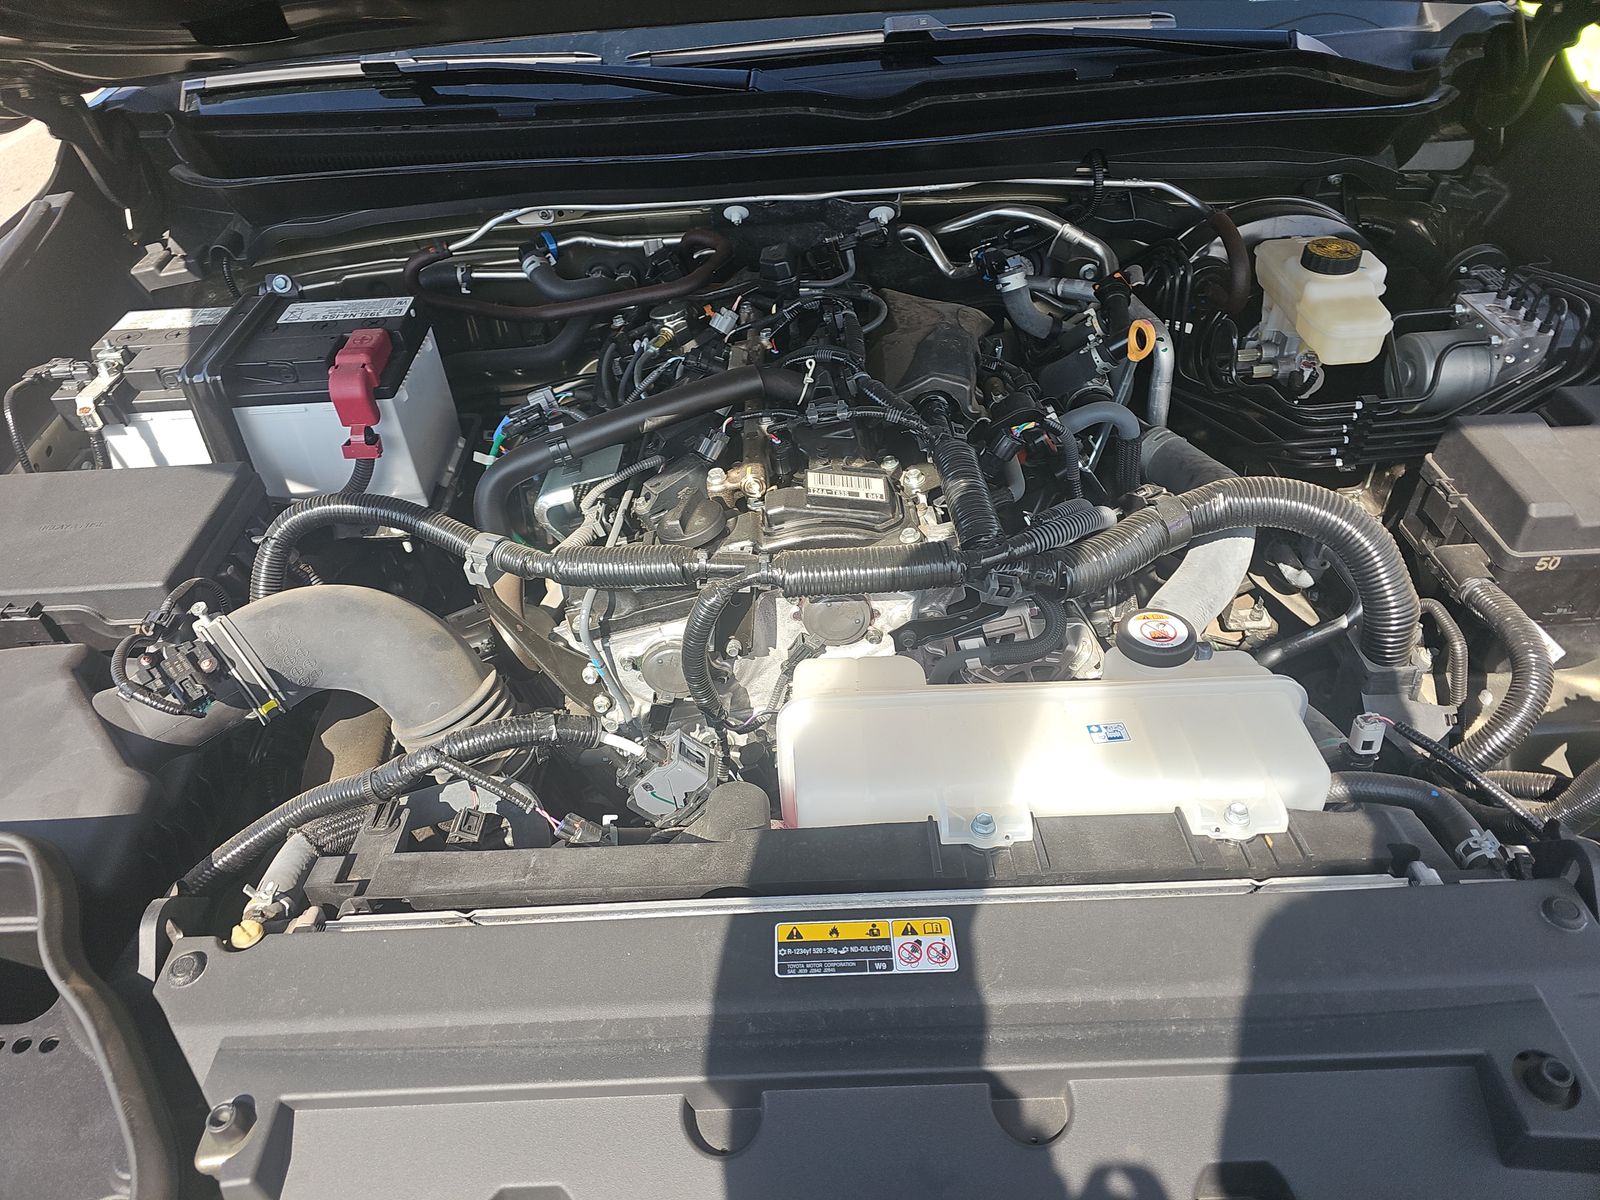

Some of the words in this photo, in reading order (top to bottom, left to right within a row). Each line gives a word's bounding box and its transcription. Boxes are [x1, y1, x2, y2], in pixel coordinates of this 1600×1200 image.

[1534, 556, 1562, 572] 50
[787, 947, 812, 956] R-1234yf
[874, 962, 887, 970] W9
